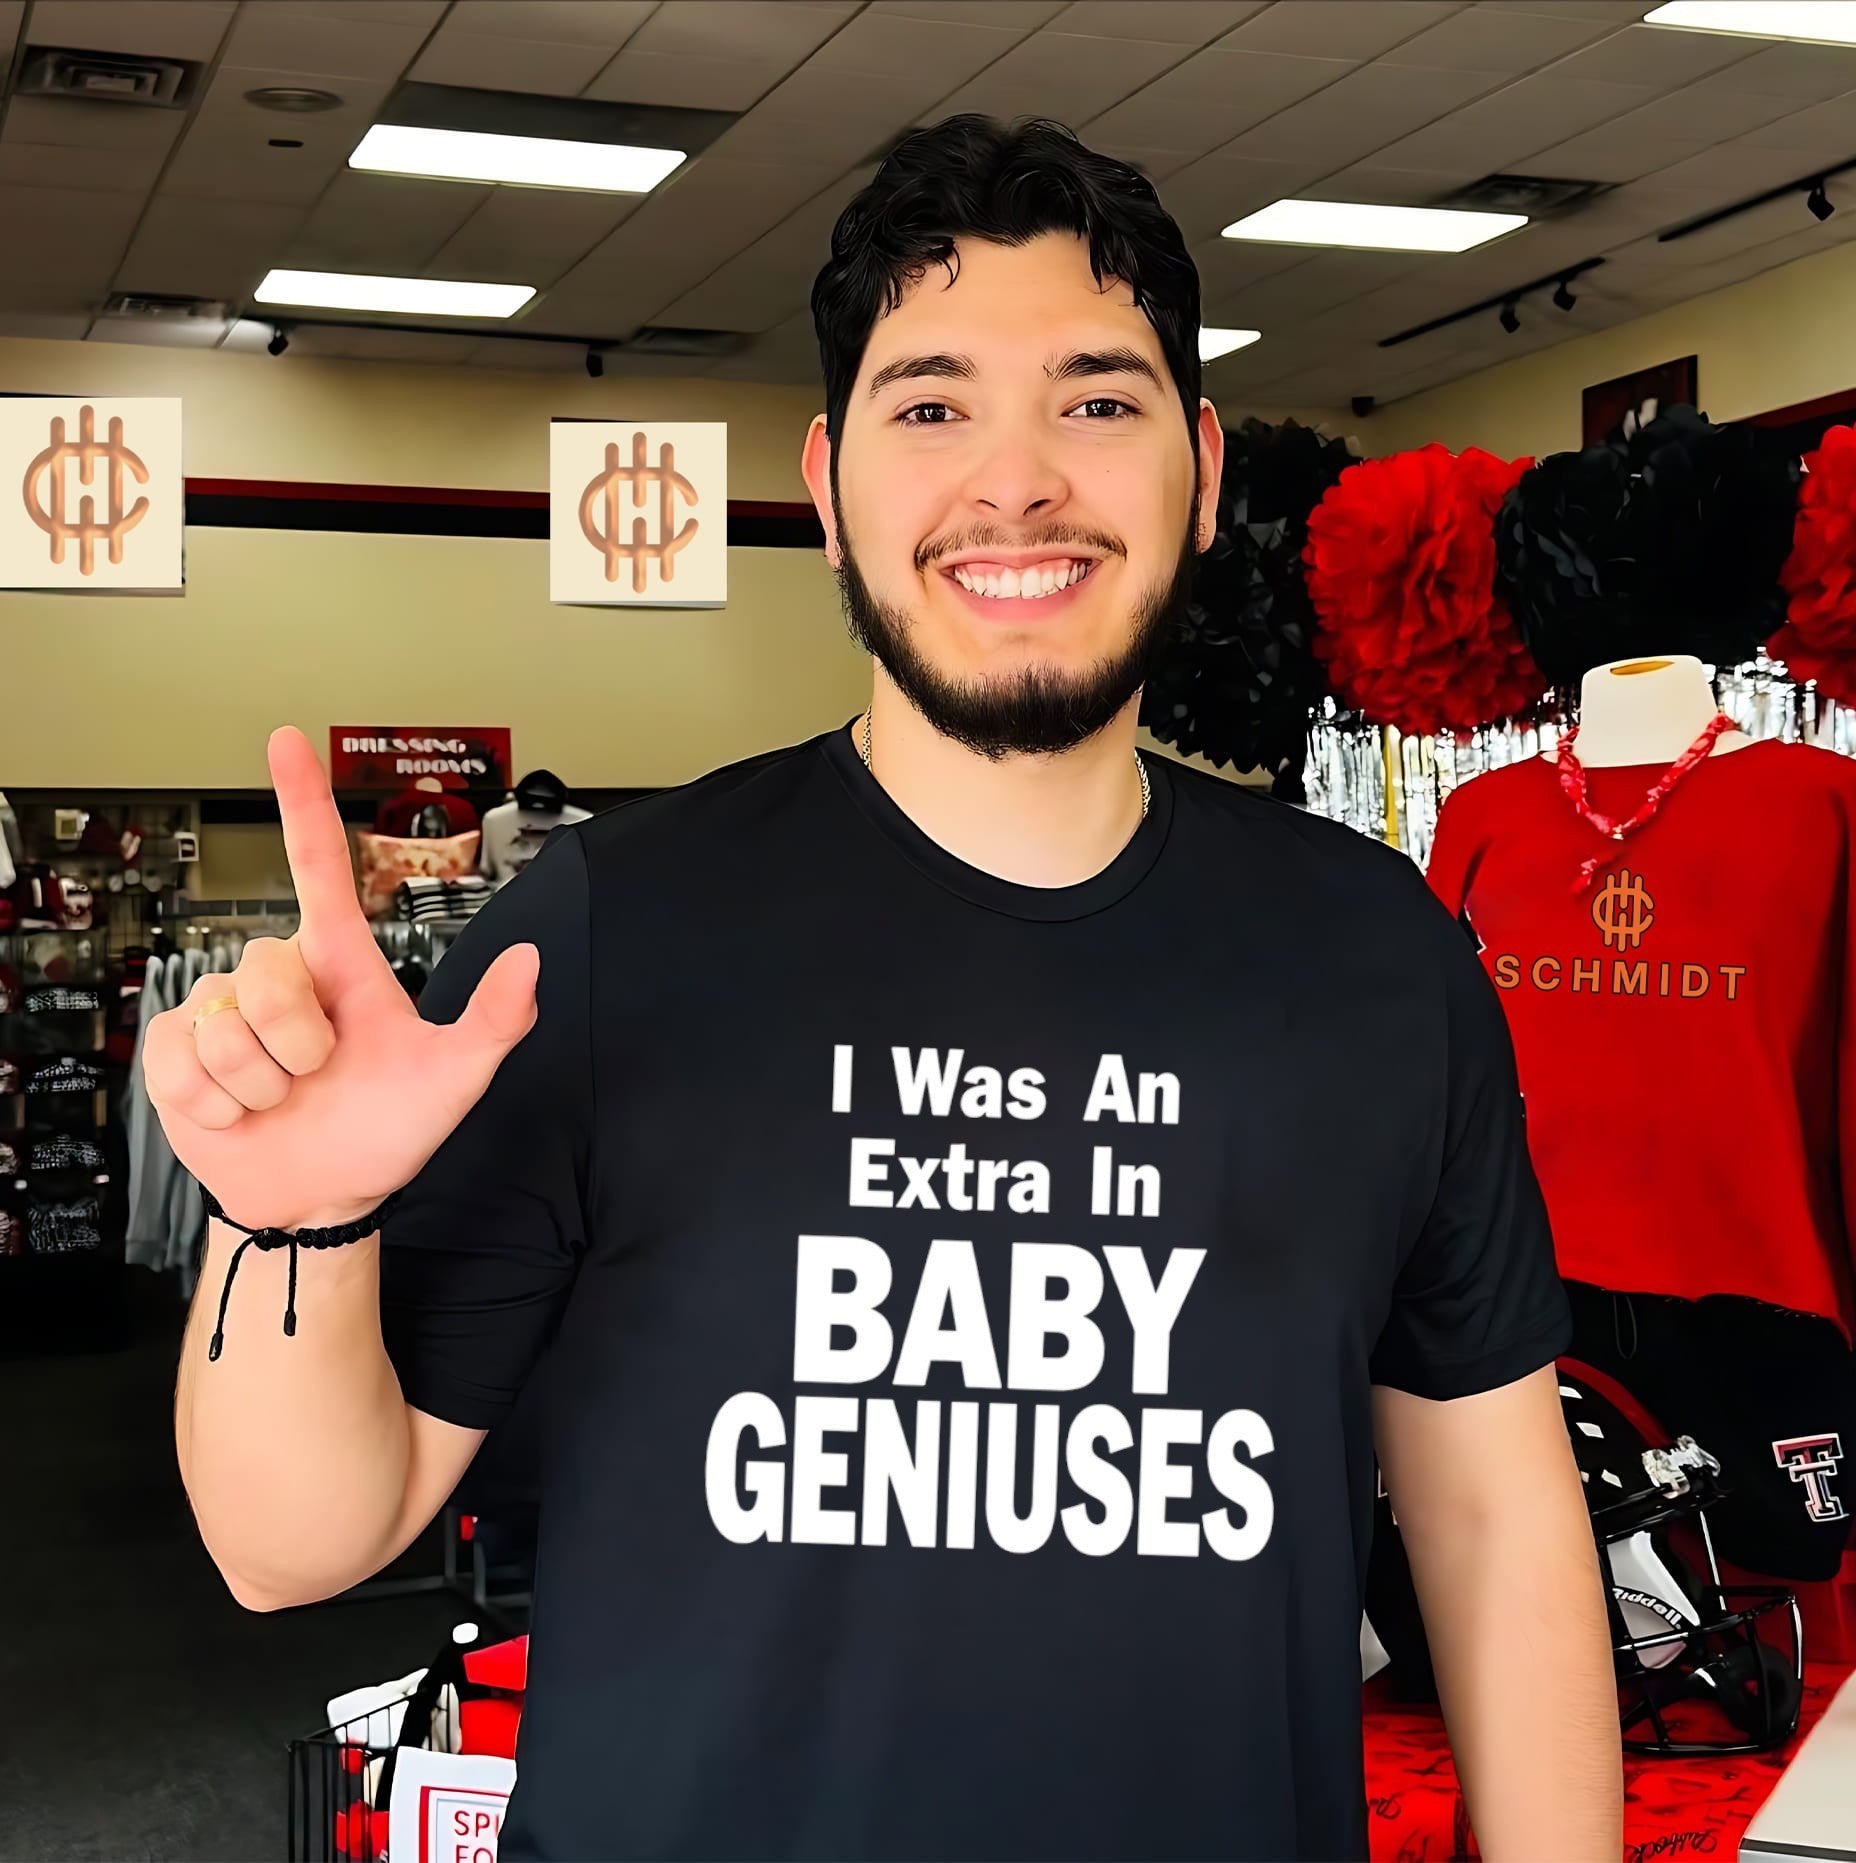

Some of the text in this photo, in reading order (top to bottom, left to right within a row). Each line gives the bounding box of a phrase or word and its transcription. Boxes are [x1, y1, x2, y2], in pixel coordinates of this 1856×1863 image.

[396, 758, 487, 775] ROOMS
[1494, 954, 1747, 1001] SCHMIDT
[832, 1044, 1181, 1125] I Was An
[849, 1137, 1161, 1217] Extra In
[793, 1234, 1208, 1395] BABY
[705, 1391, 1275, 1562] GENIUSES
